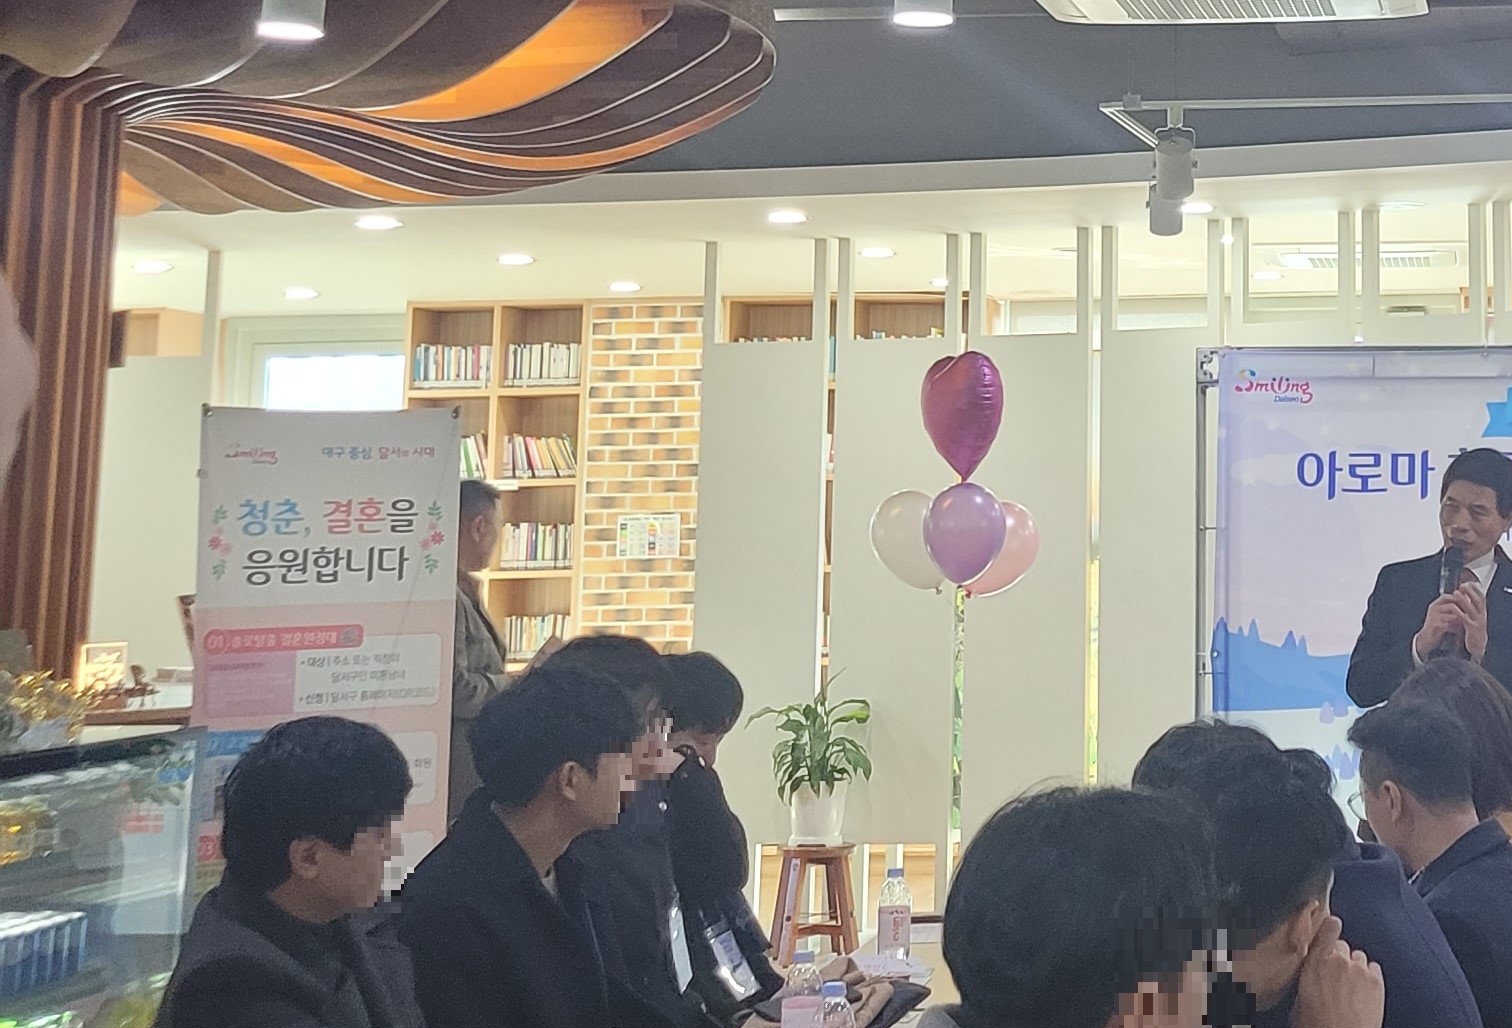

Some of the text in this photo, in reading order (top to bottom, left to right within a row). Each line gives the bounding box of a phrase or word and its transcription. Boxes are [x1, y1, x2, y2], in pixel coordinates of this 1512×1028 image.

[1235, 369, 1313, 404] Smiling
[321, 446, 346, 460] 대구
[412, 446, 435, 458] 시대
[1297, 450, 1436, 501] 아로마
[237, 497, 419, 538] 청춘, 결혼을
[242, 546, 410, 586] 응원합니다
